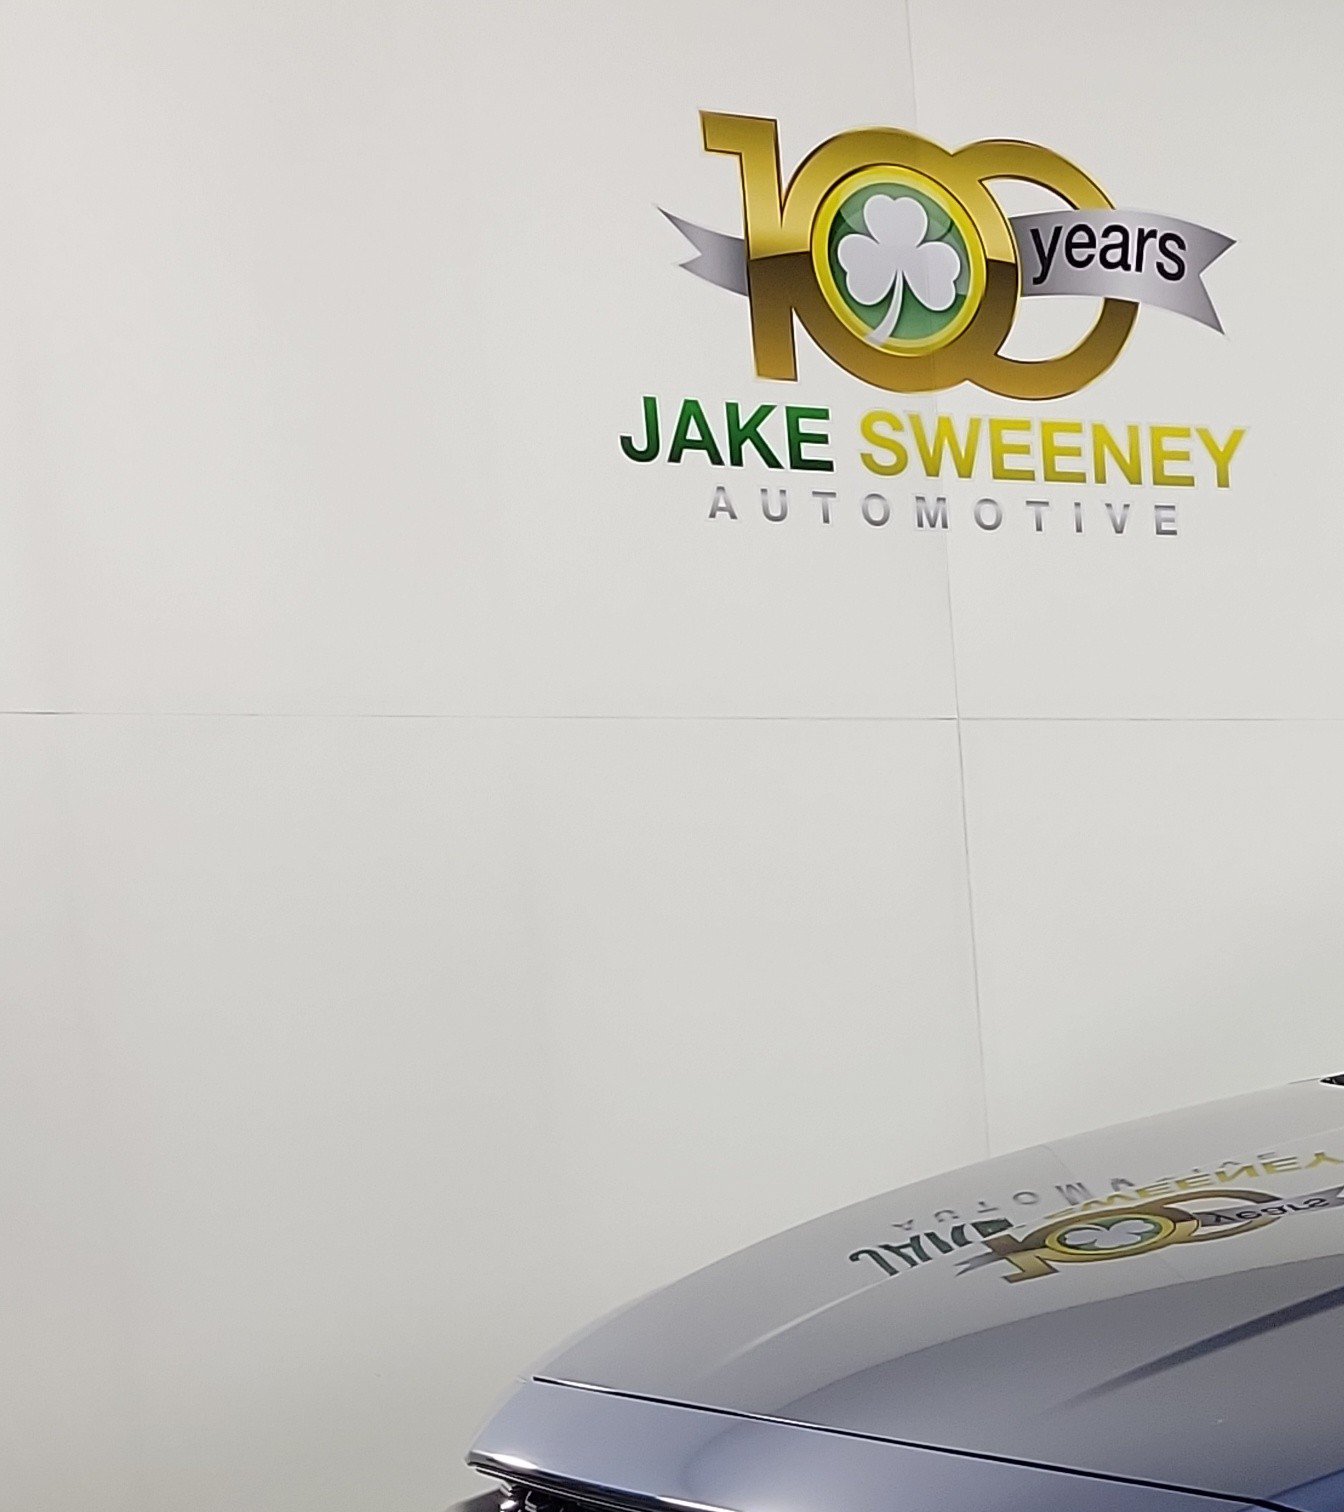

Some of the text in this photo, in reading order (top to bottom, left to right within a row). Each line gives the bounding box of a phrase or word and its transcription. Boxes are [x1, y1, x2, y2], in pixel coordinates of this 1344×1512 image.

[1030, 221, 1187, 285] years
[619, 396, 1248, 489] JAKE SWEENEY
[708, 486, 1180, 537] AUTOMOTIVE
